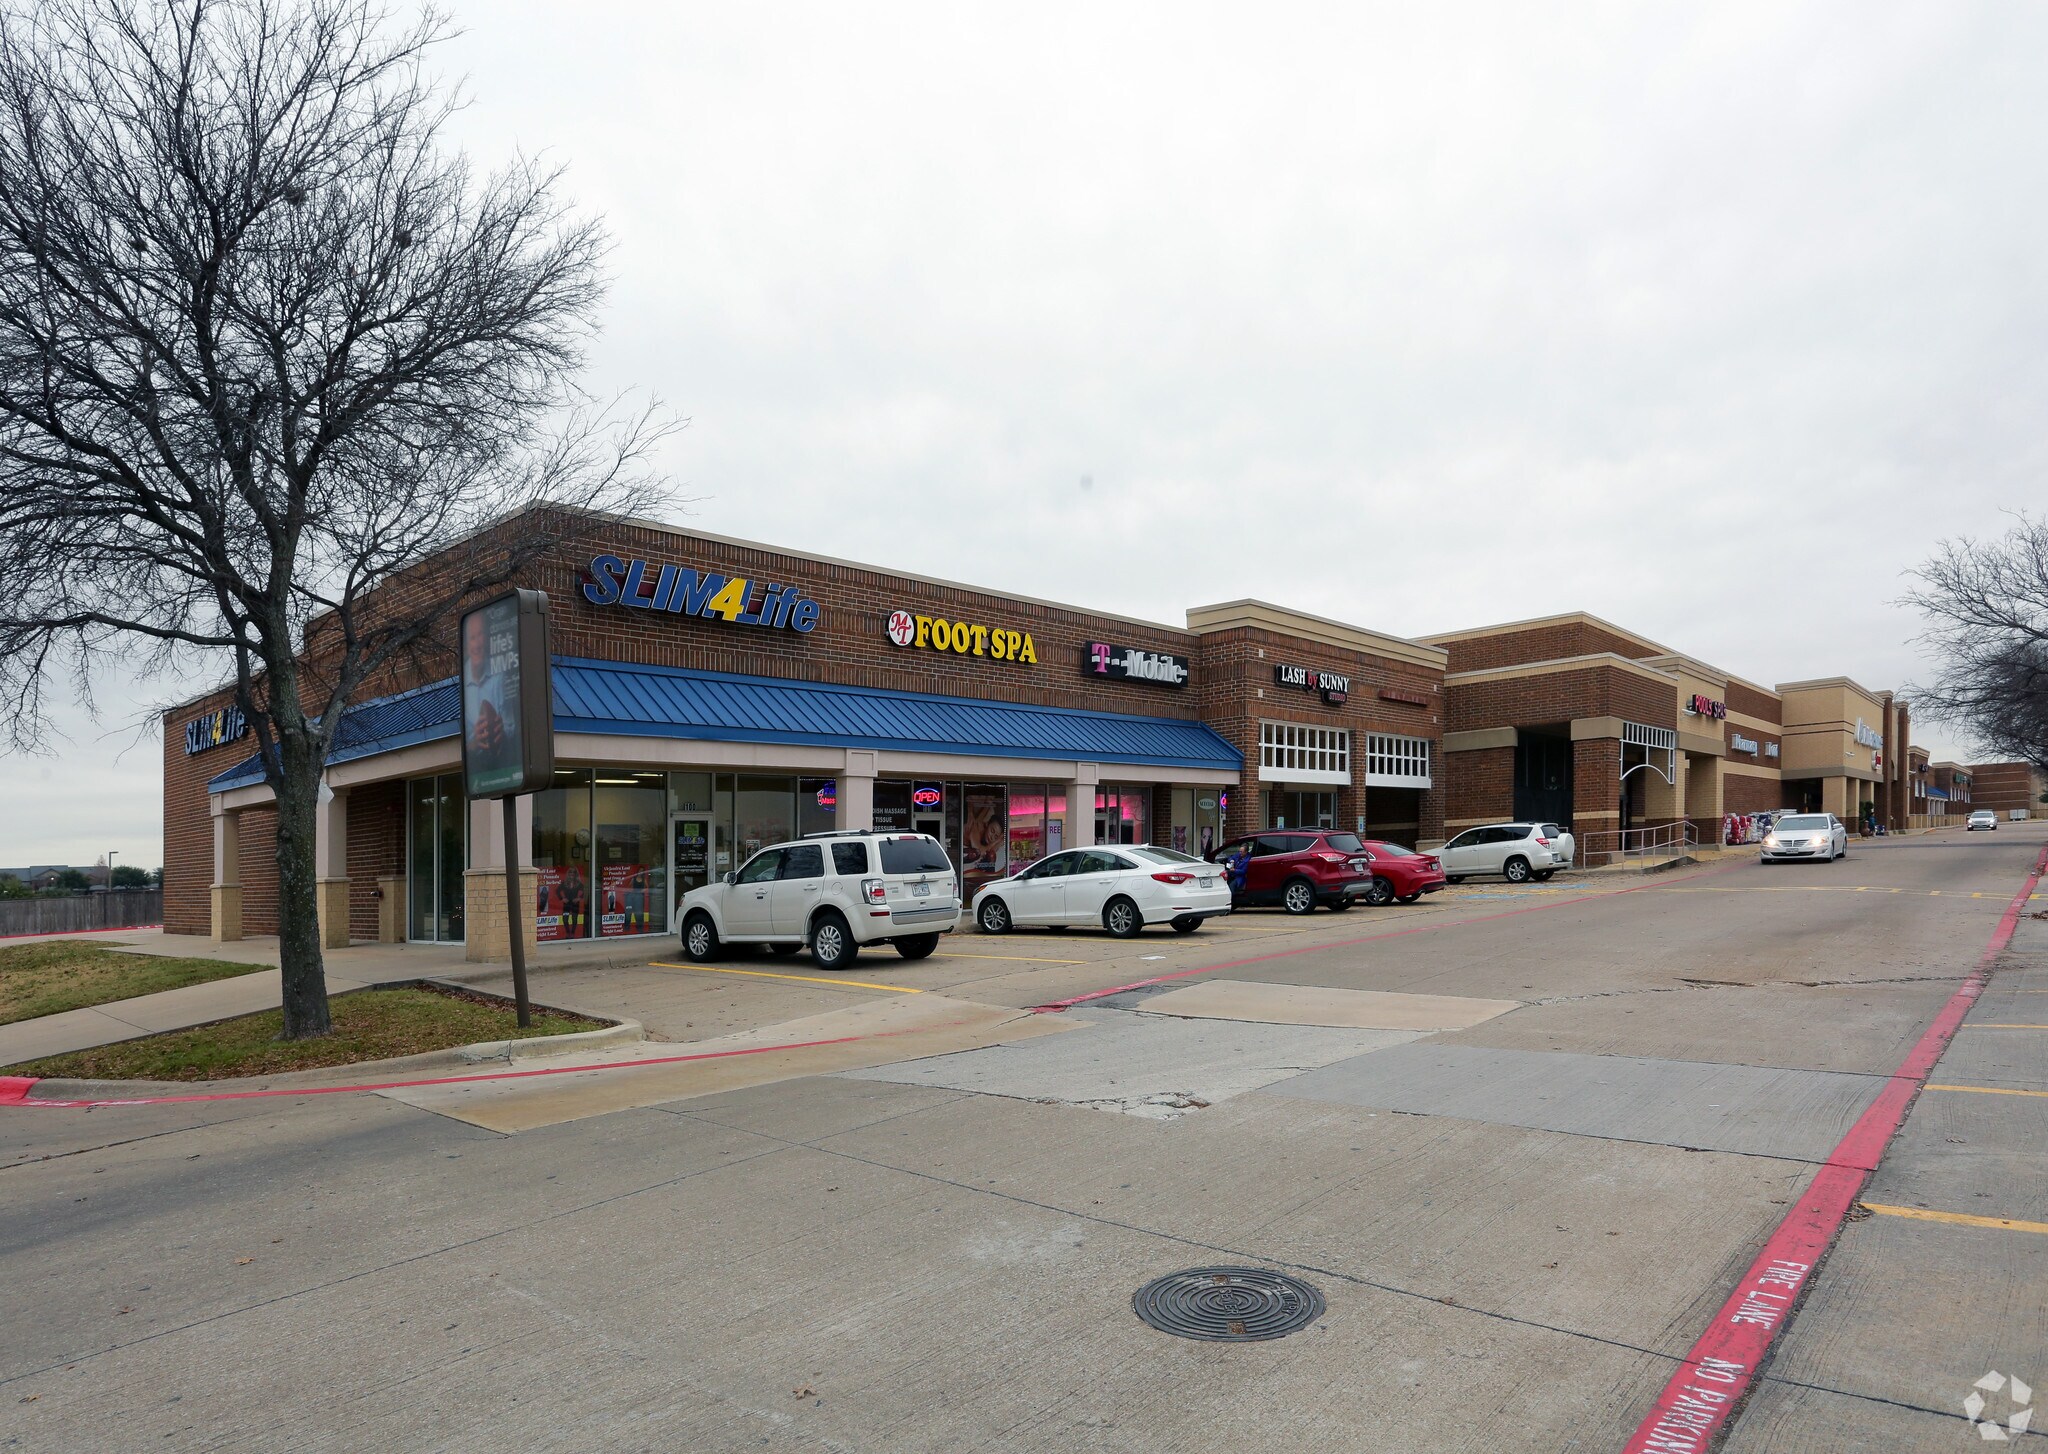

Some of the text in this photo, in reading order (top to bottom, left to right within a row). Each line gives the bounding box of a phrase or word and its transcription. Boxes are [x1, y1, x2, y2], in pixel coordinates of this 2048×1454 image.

[583, 554, 821, 633] SLIM4Life
[490, 631, 513, 655] life's
[914, 614, 1038, 664] FOOT SPA
[490, 651, 519, 675] MVPs
[1281, 665, 1350, 692] LASH by SUNNY
[1695, 695, 1713, 716] POOLS
[913, 791, 940, 803] OPEN
[1730, 1259, 1809, 1330] FIRE LANE
[1638, 1356, 1745, 1454] NO PARKIN
